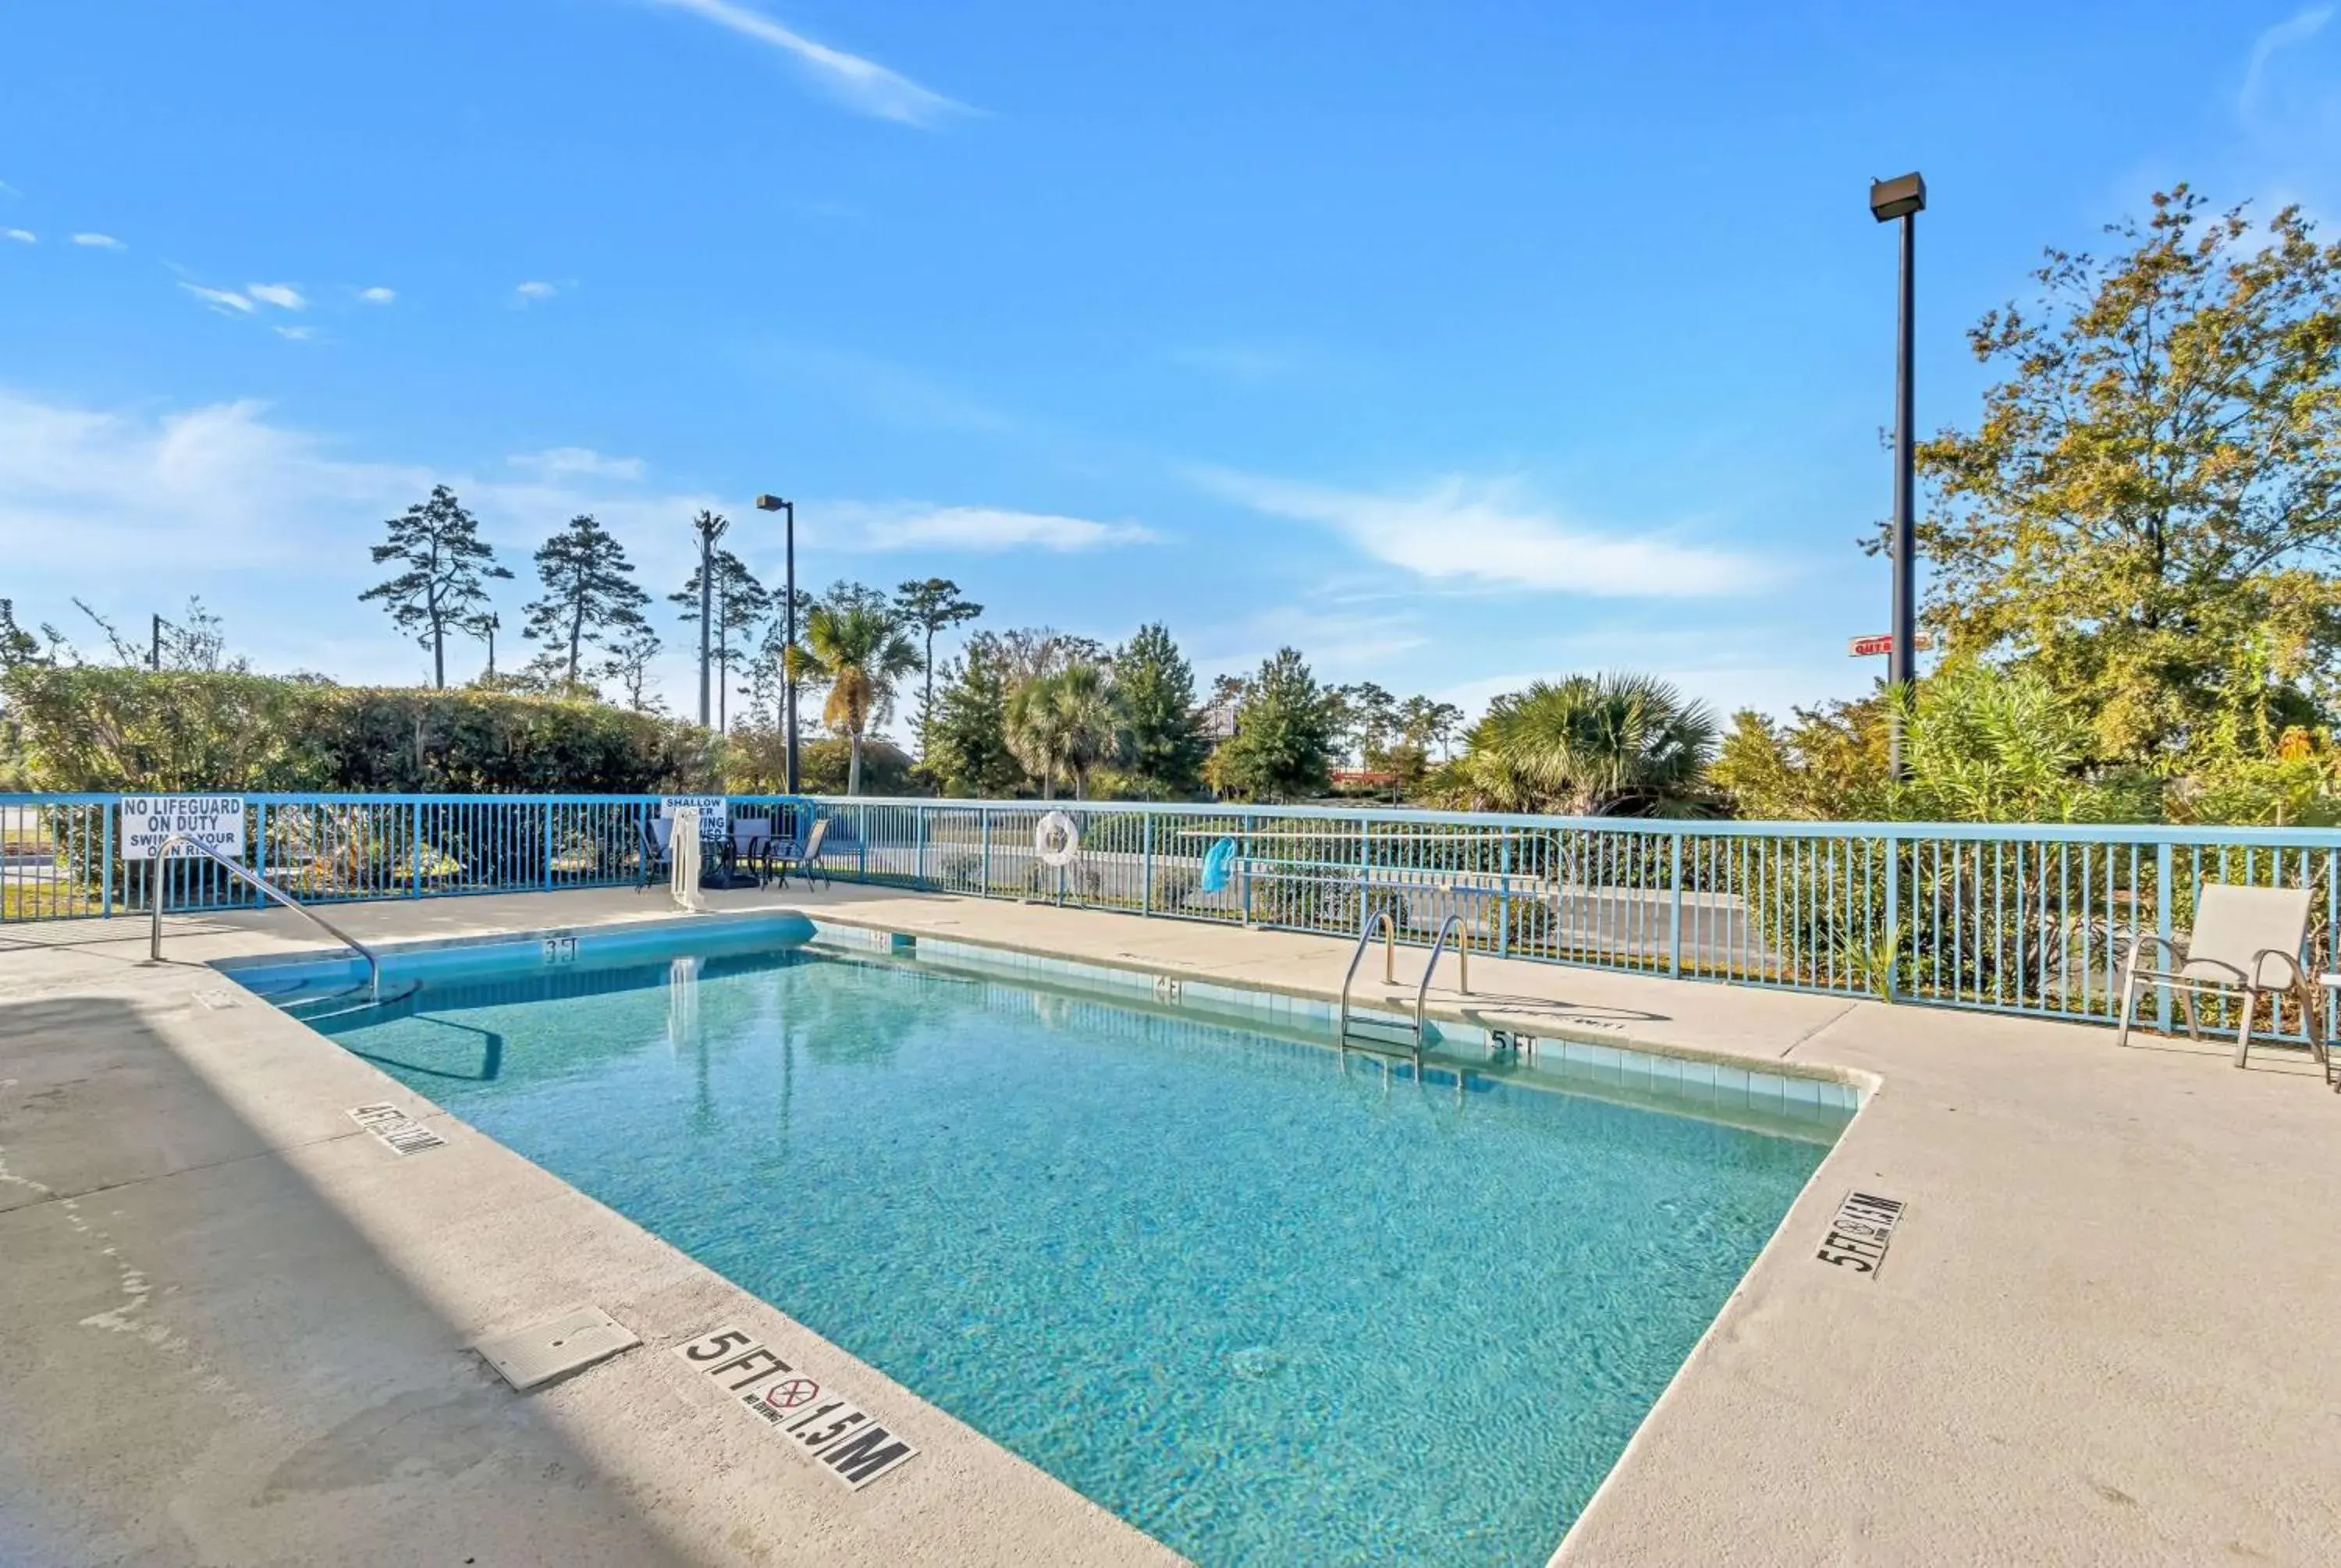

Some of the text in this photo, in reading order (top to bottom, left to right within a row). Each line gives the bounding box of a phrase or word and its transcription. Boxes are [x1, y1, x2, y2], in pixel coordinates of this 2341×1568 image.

[125, 799, 240, 814] NO LIFEGUARD
[148, 816, 218, 832] ON DUTY
[147, 845, 179, 857] ON
